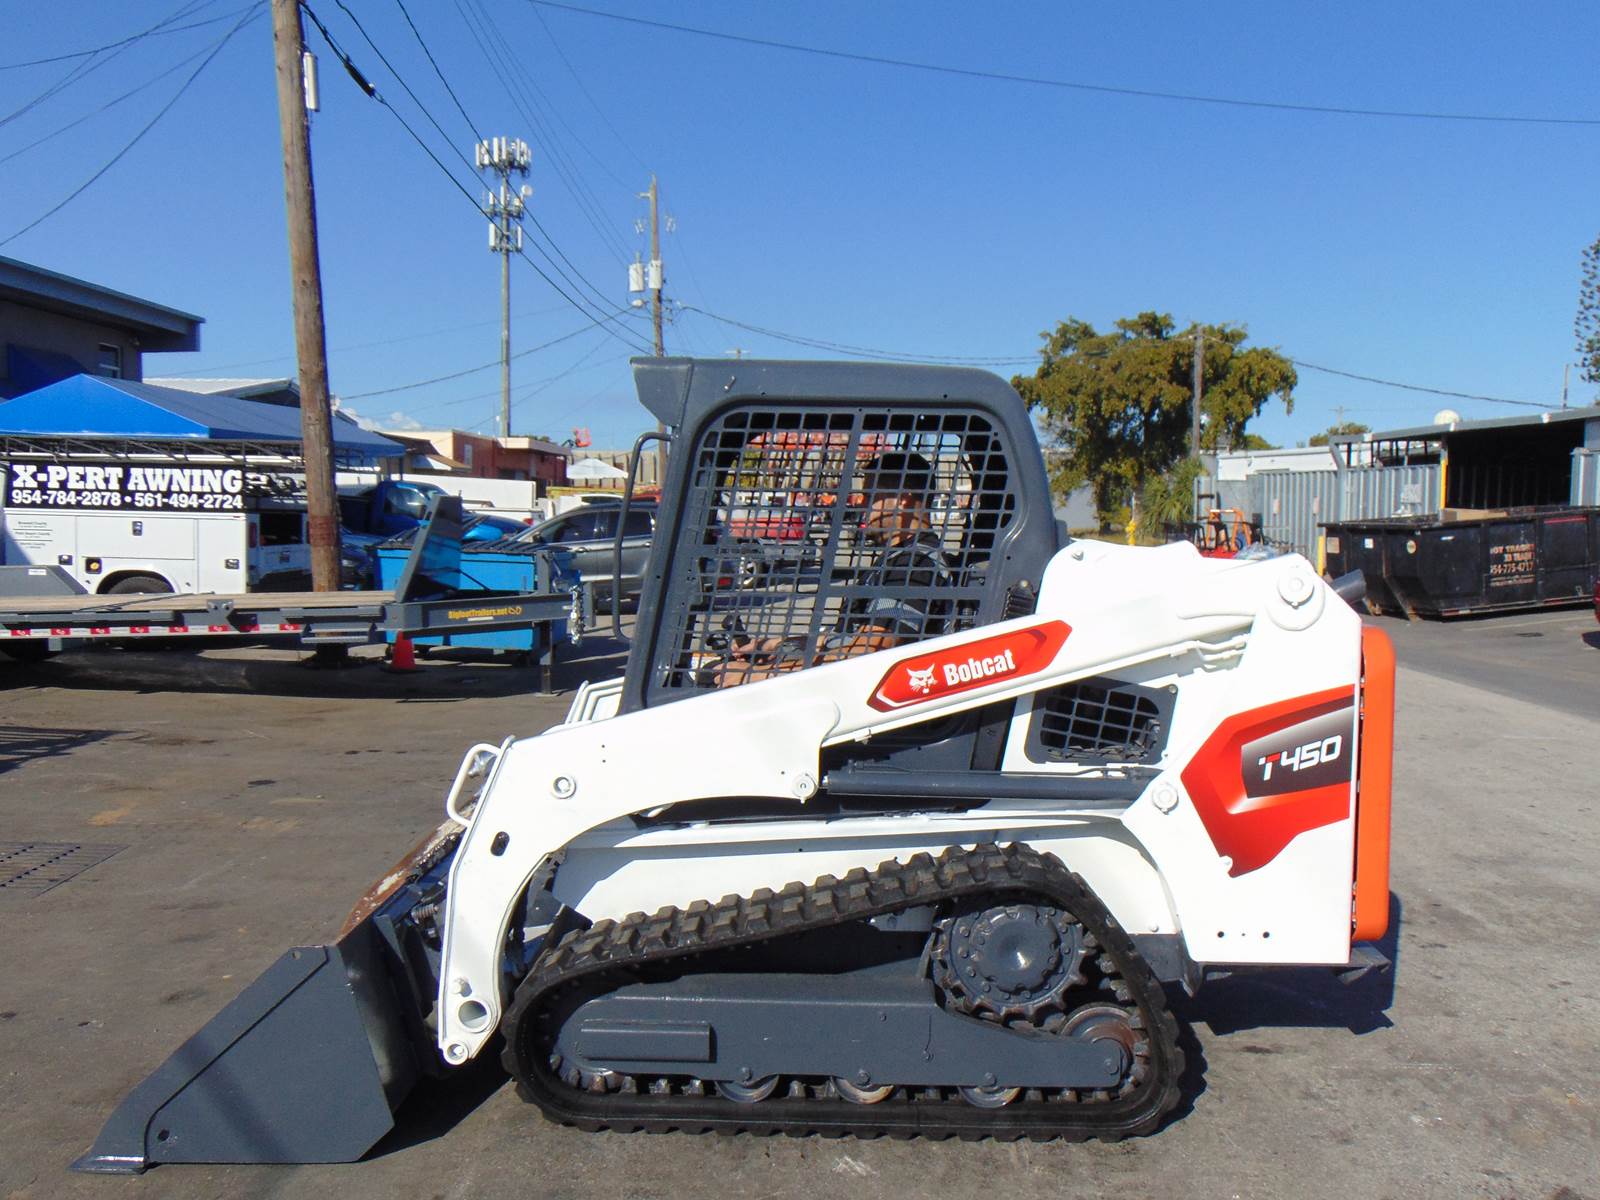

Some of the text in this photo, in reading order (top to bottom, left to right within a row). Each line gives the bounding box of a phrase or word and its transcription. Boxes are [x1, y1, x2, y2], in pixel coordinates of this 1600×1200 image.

[12, 464, 243, 493] X-PERT AWNING
[12, 490, 243, 509] 954-784-2878 561-494-2724
[943, 649, 1016, 686] Bobcat
[1258, 735, 1342, 781] T450
